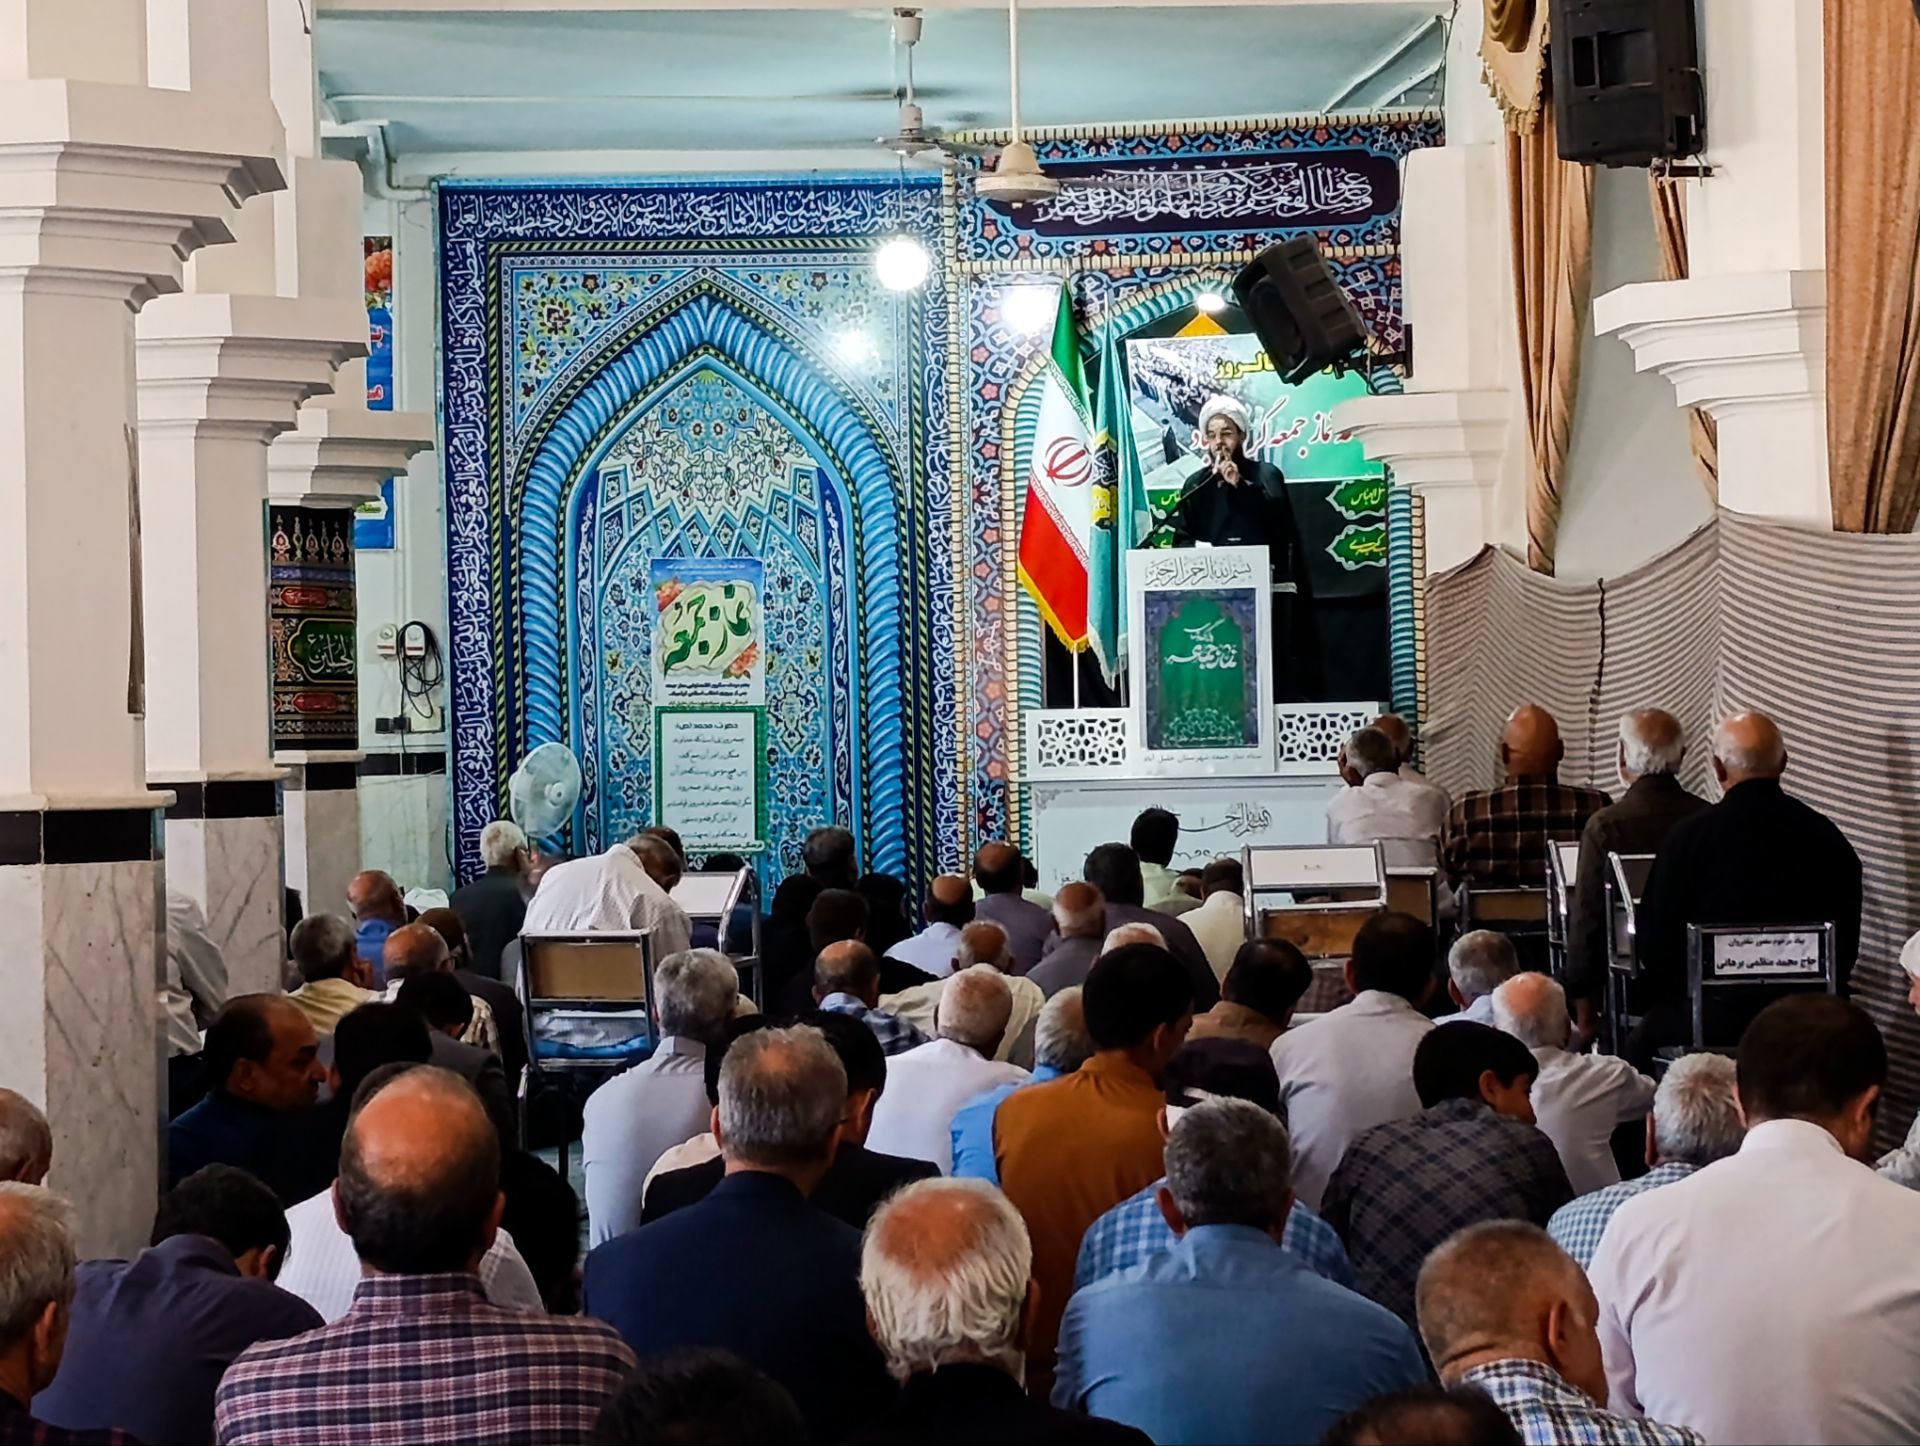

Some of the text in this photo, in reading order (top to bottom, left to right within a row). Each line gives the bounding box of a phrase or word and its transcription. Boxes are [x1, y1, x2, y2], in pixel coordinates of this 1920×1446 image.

[1270, 419, 1305, 456] جمعه
[664, 584, 751, 679] نماز جمعه
[1801, 957, 1817, 968] حاج
